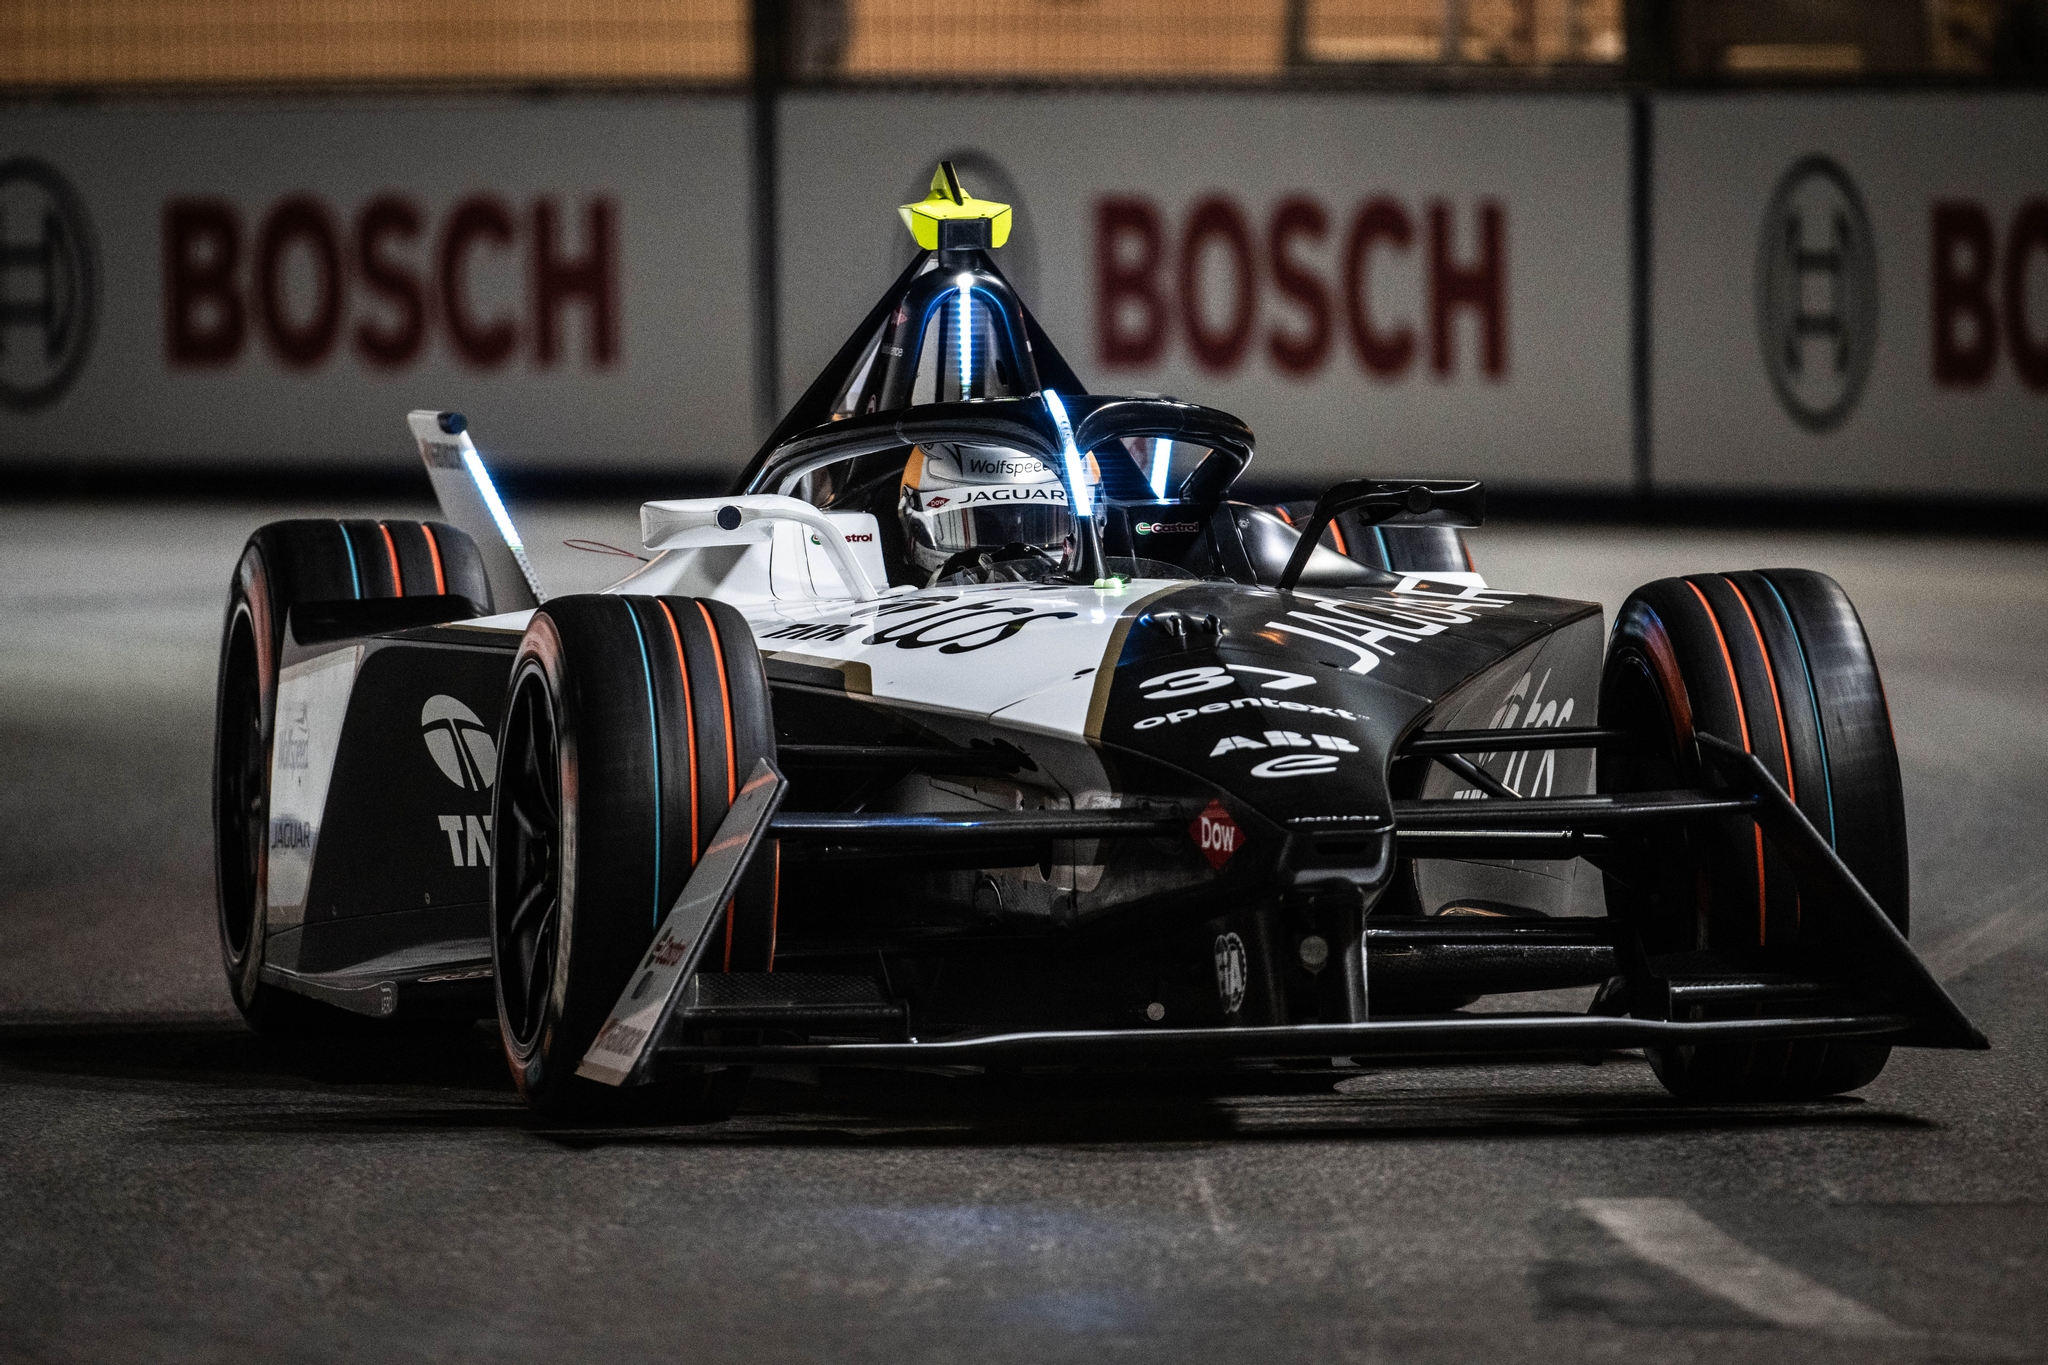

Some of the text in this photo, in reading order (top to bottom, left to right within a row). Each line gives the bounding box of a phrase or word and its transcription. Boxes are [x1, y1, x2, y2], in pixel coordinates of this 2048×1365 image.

[162, 192, 620, 372] BOSCH
[1092, 192, 1508, 381] BOSCH
[958, 489, 1065, 504] JAGUAR
[845, 533, 872, 542] strol
[1151, 522, 1199, 534] Castrol
[1264, 576, 1530, 675] JAGUAR
[1139, 663, 1317, 699] 37
[1209, 730, 1360, 758] ABB
